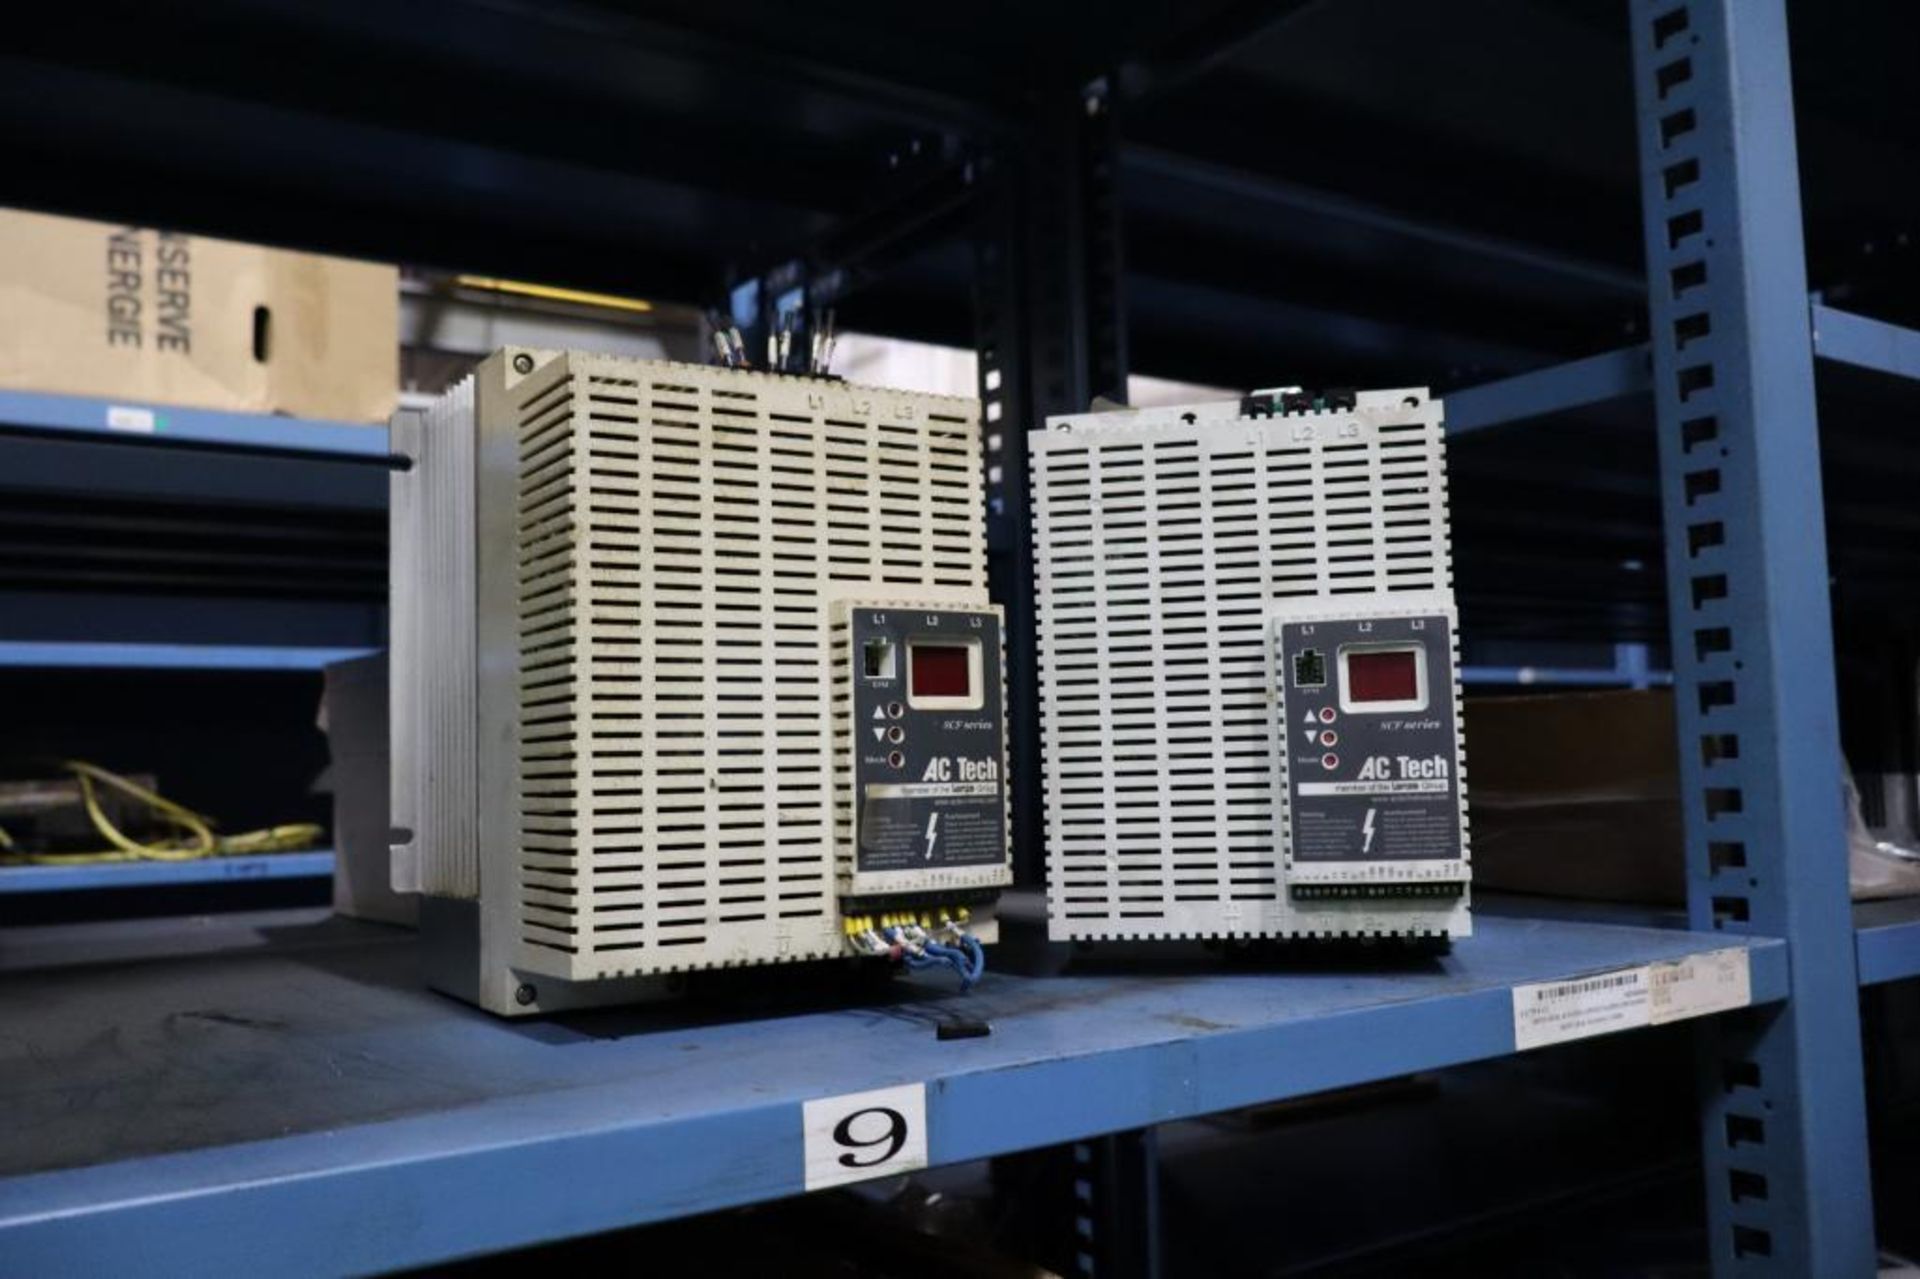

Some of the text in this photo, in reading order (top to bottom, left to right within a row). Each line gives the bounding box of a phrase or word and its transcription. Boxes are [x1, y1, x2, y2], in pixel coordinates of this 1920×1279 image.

[1291, 426, 1315, 442] L2
[1337, 423, 1360, 438] L3
[873, 613, 886, 625] L1
[1301, 620, 1425, 636] L1 L2 L3
[1404, 718, 1441, 730] series
[922, 755, 998, 782] AC Tech
[1357, 754, 1449, 780] AC Tech
[832, 1106, 908, 1168] 9
